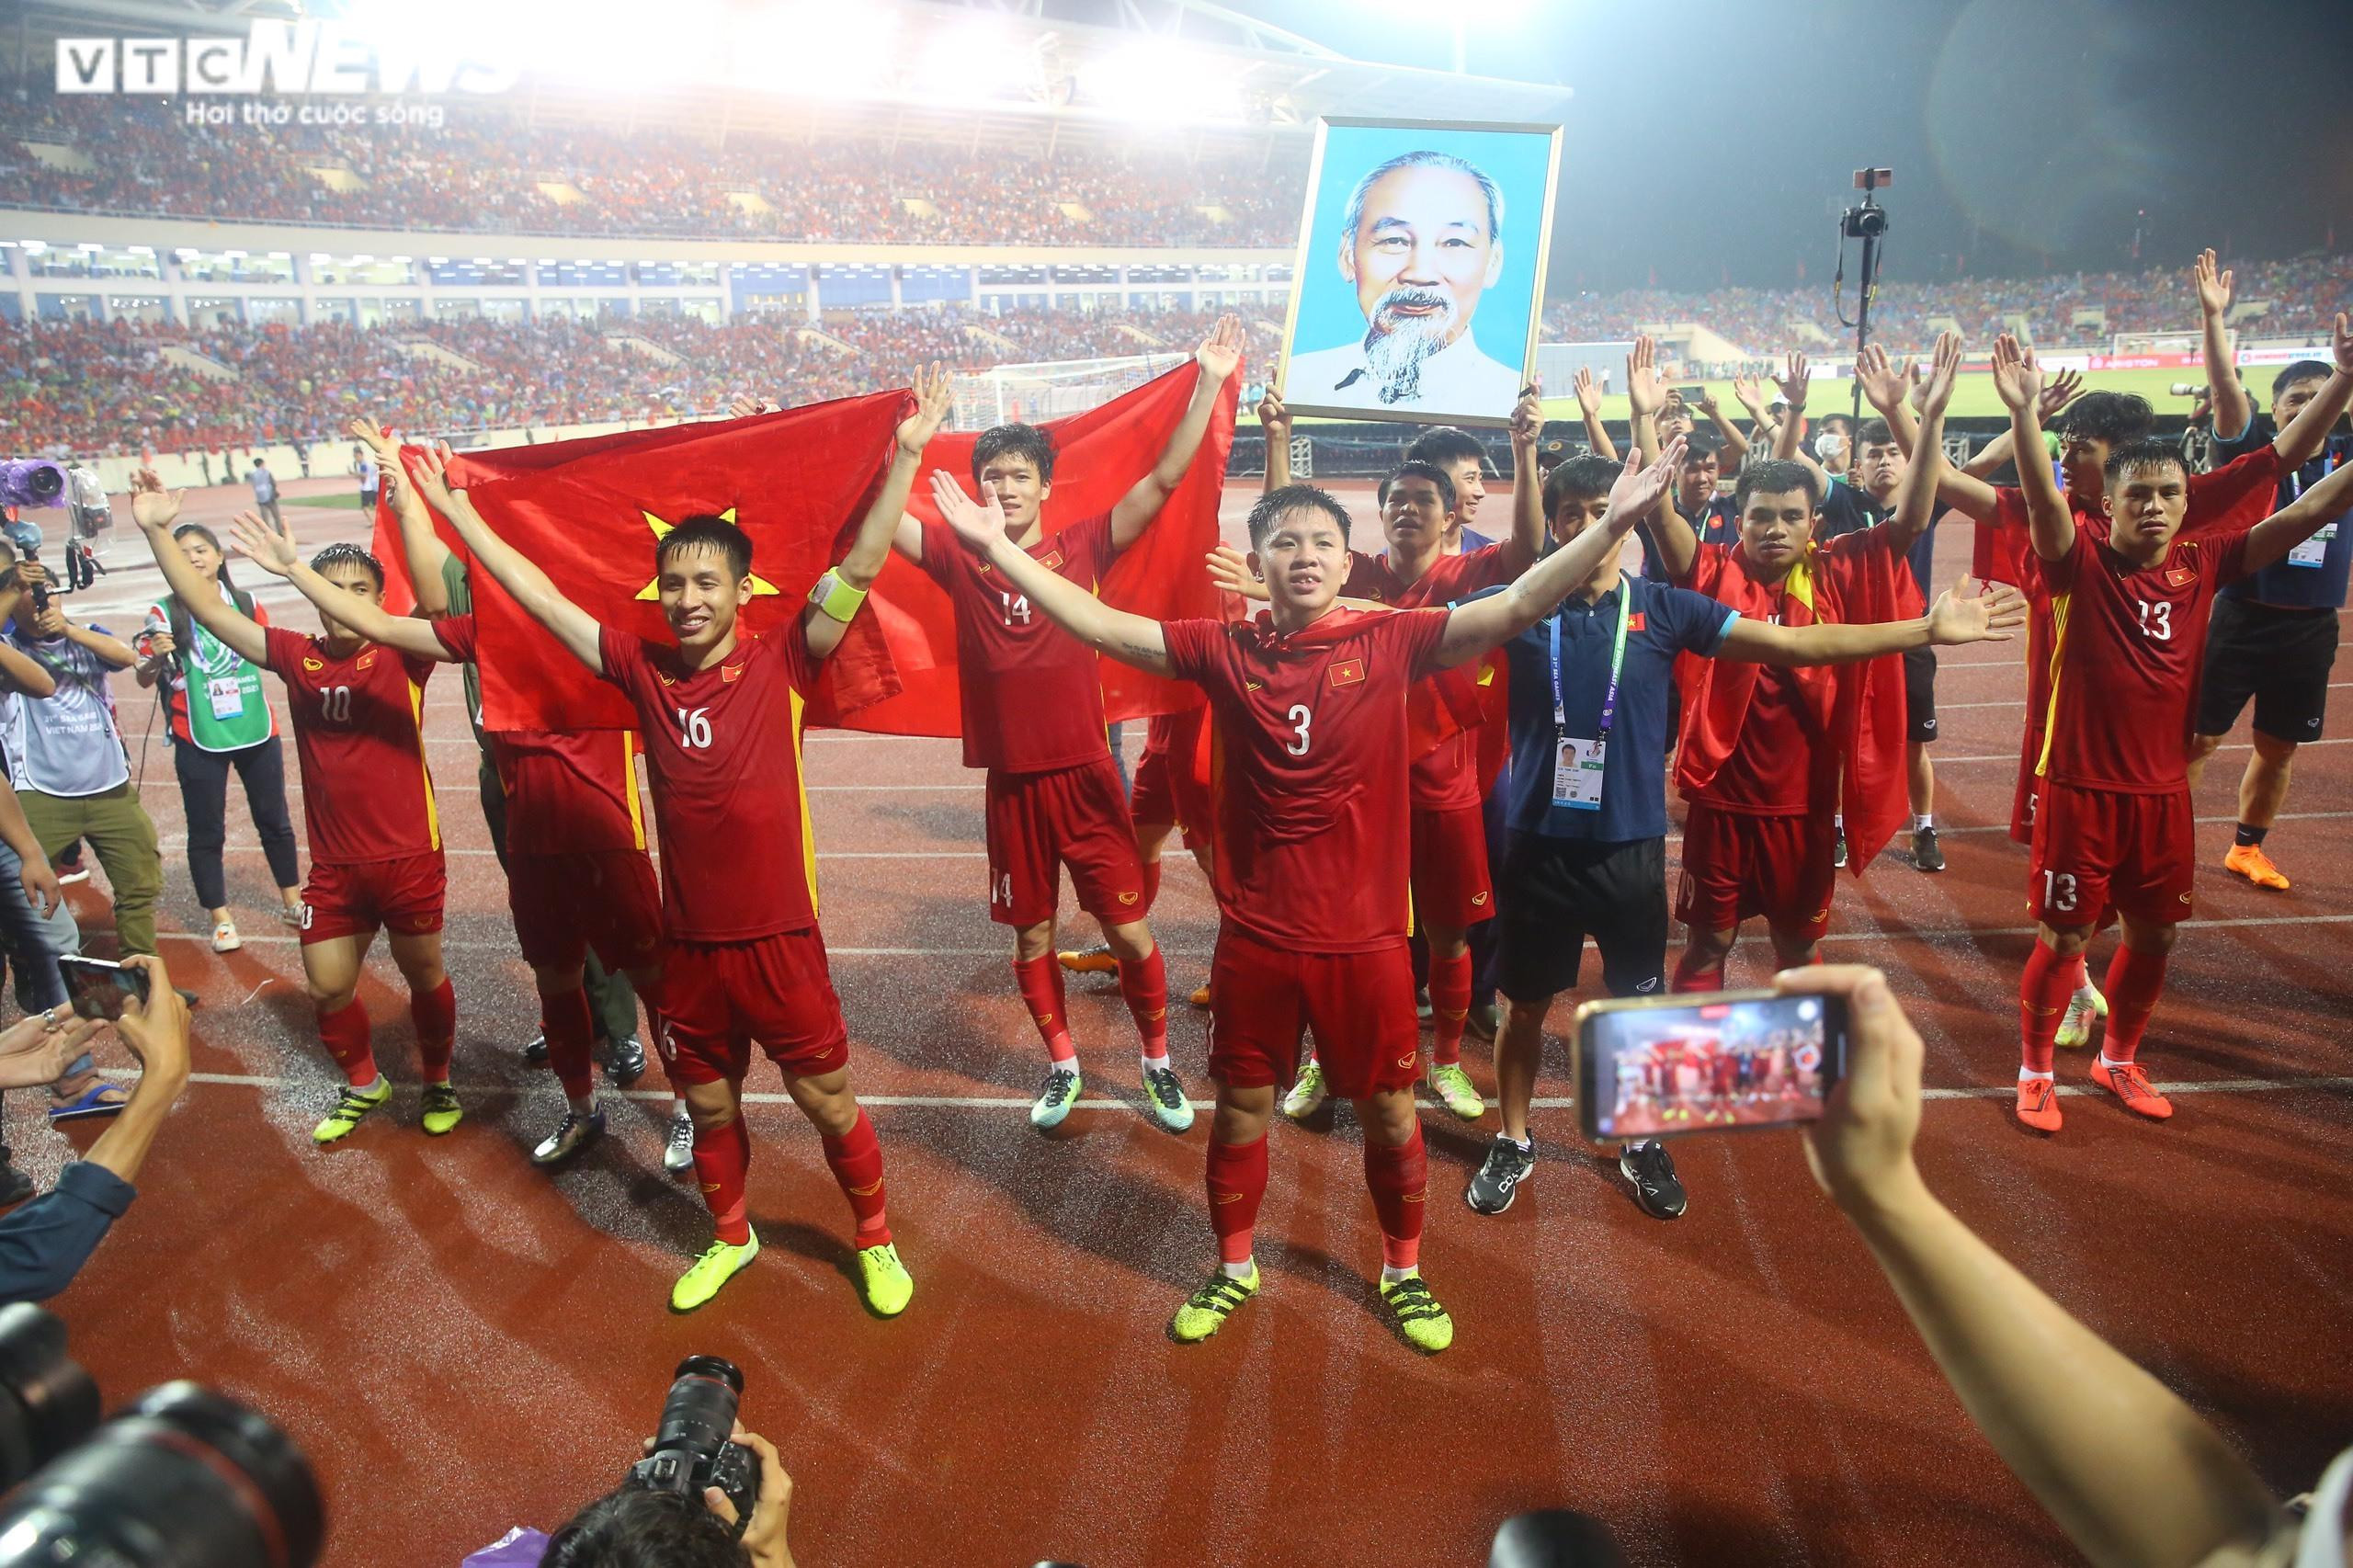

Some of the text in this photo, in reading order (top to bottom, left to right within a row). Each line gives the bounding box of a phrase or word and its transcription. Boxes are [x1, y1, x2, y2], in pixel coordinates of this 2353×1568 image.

[1000, 590, 1031, 626] 14
[2138, 599, 2172, 641] 13
[320, 686, 351, 722] 10
[1608, 686, 1616, 701] ASIA
[677, 707, 712, 748] 16
[1287, 704, 1312, 756] 3
[992, 868, 1013, 908] 14
[2044, 869, 2077, 911] 13
